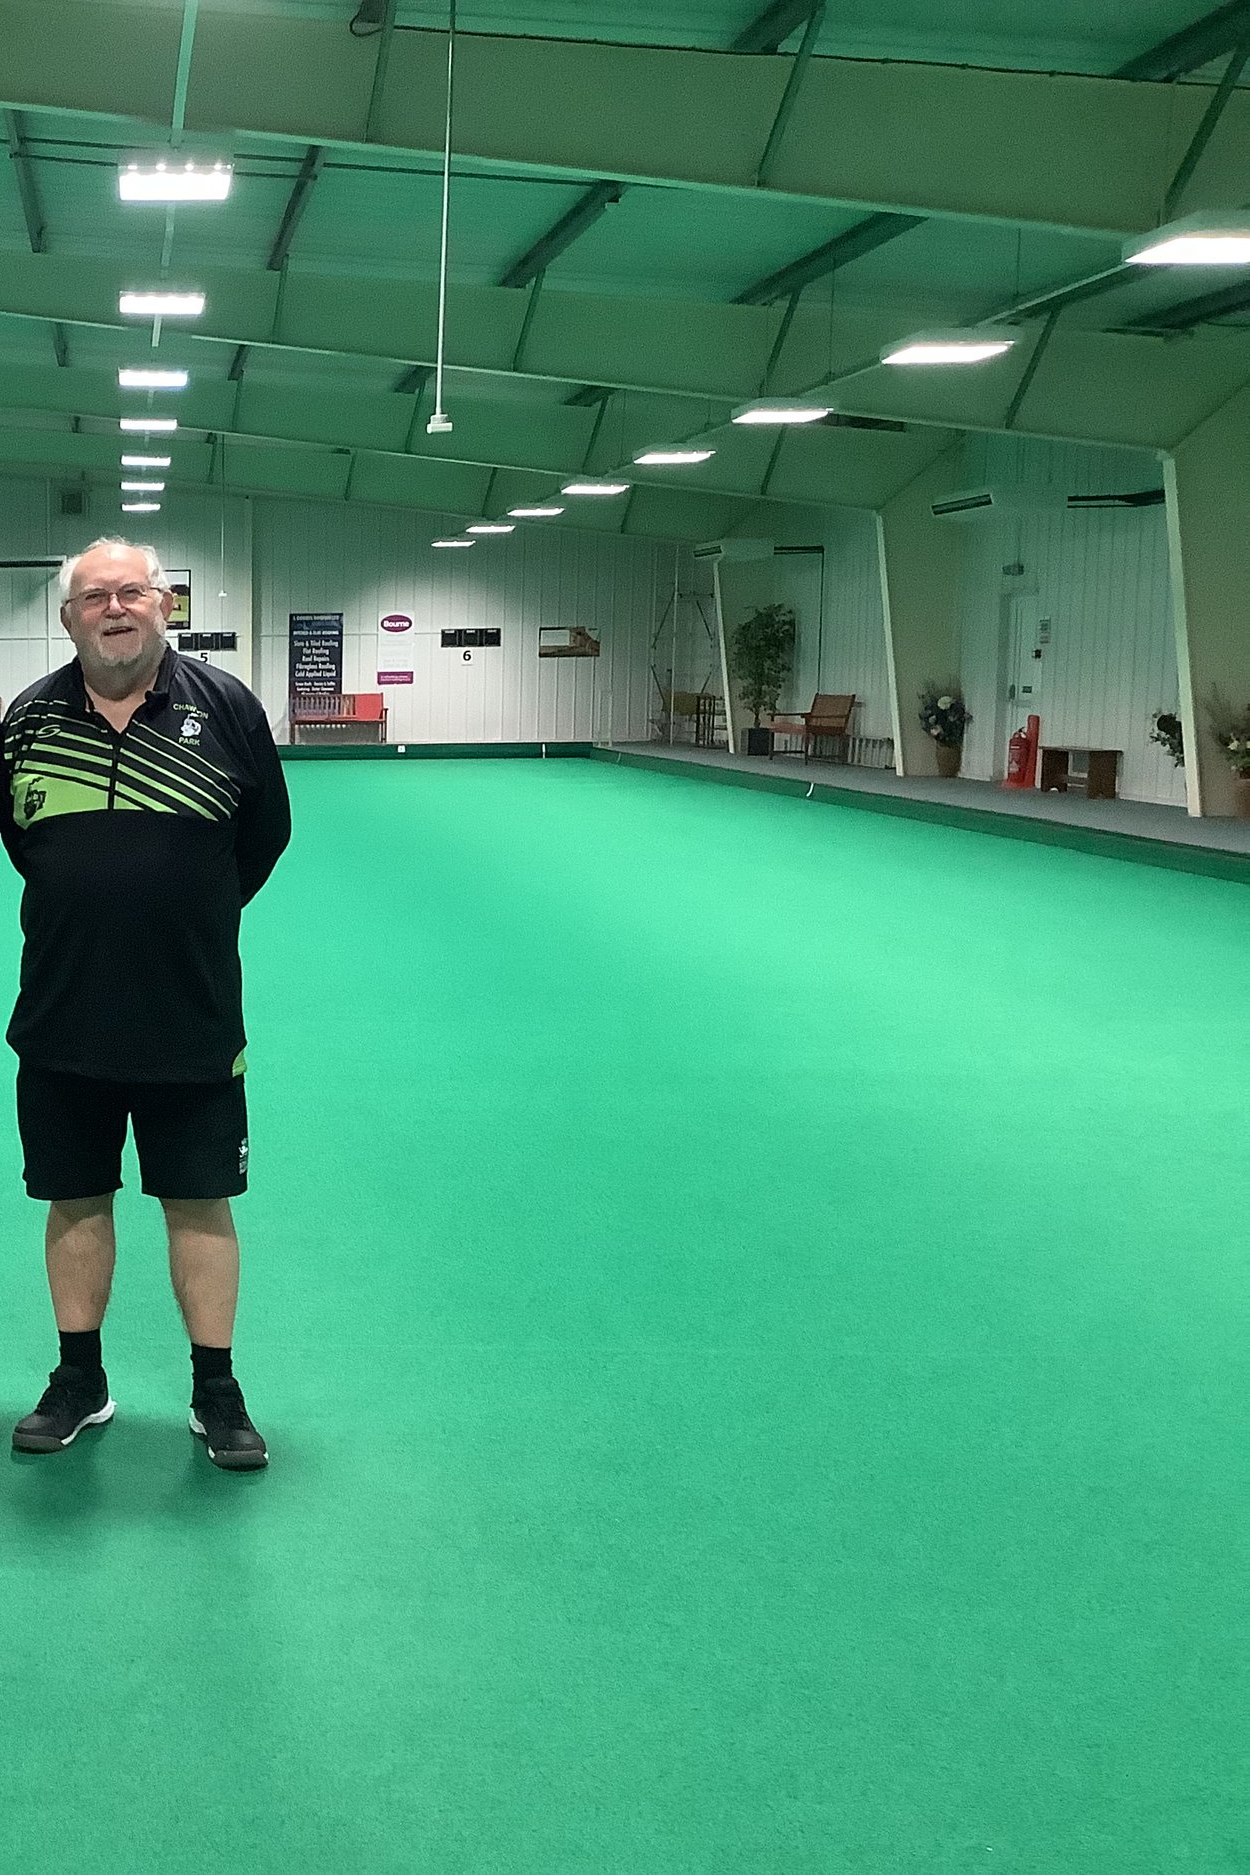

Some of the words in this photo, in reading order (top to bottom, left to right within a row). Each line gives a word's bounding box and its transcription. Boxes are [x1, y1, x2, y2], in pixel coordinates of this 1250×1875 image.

[200, 652, 208, 663] 5
[462, 650, 472, 661] 6
[173, 703, 209, 719] CHAWON
[178, 736, 201, 746] PARK
